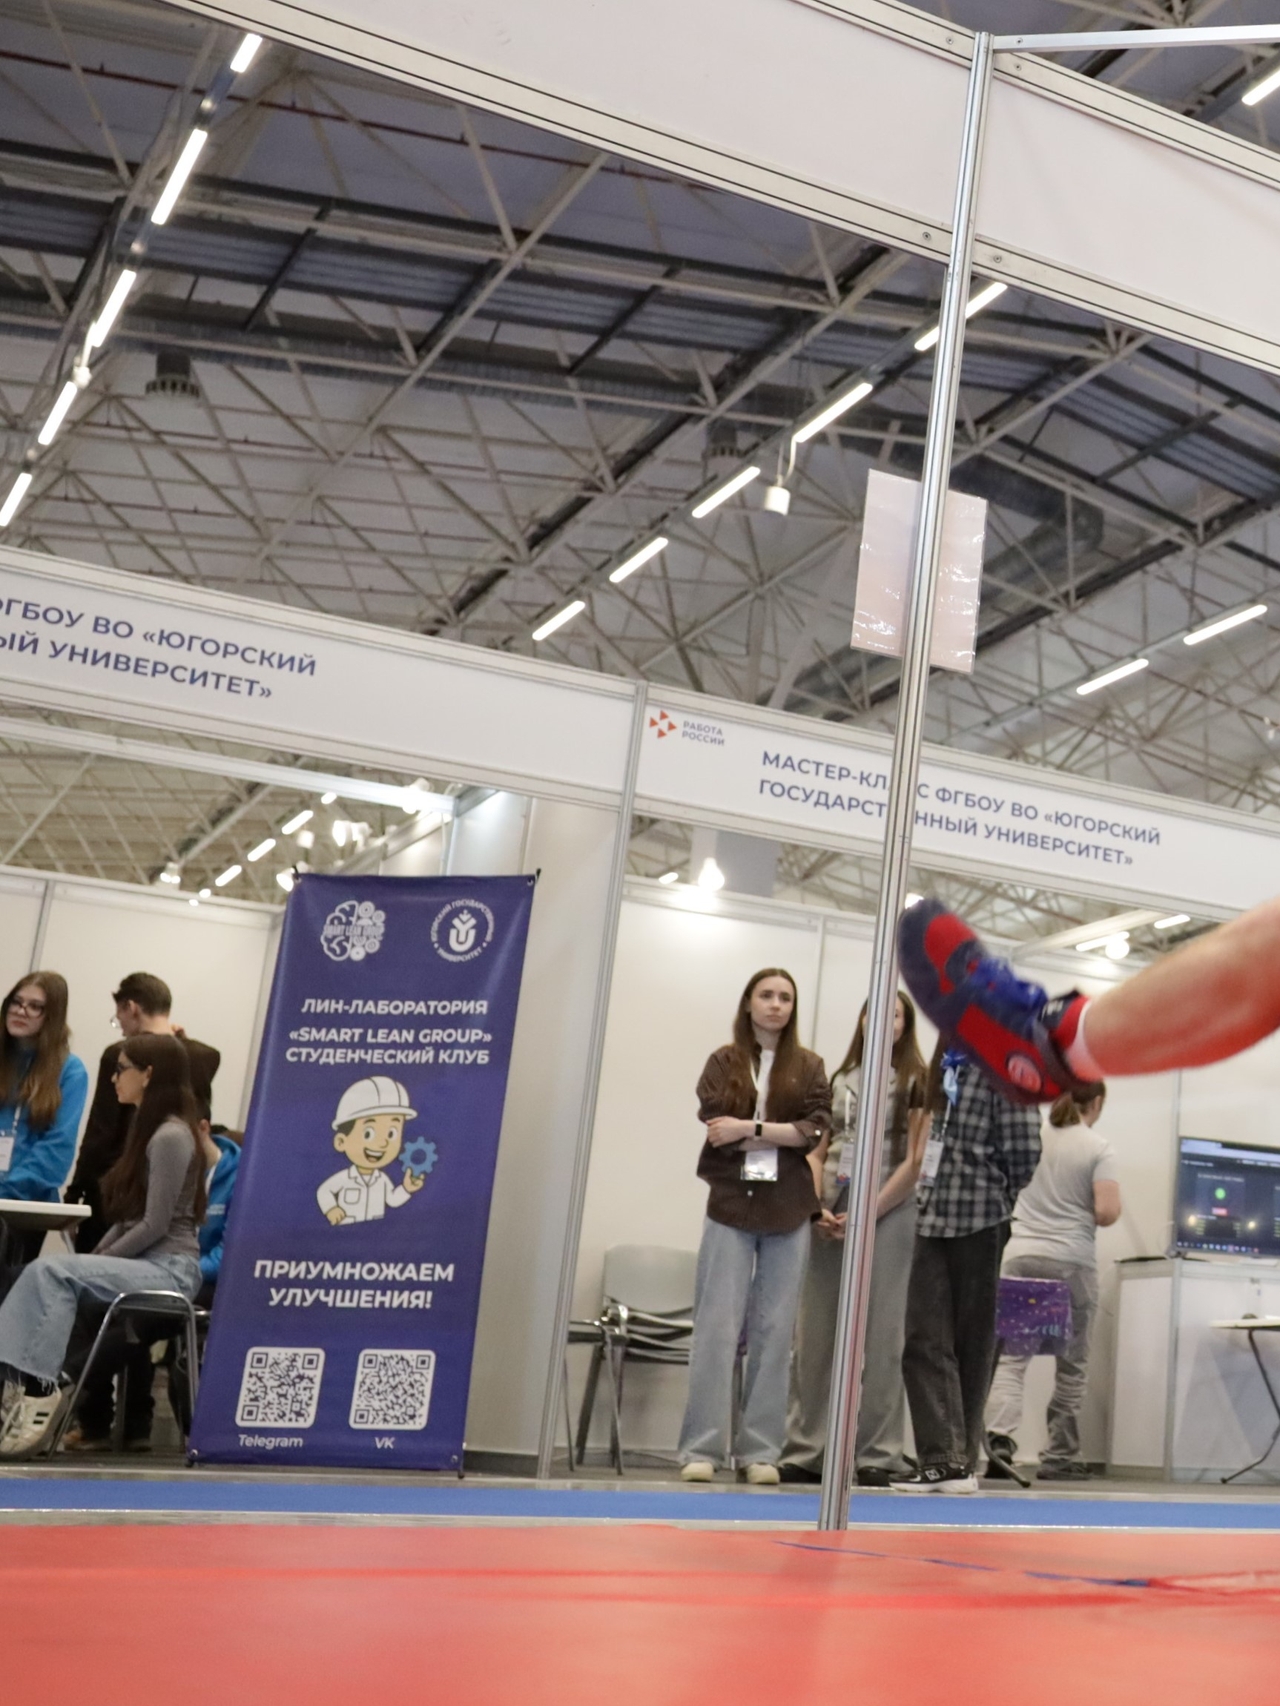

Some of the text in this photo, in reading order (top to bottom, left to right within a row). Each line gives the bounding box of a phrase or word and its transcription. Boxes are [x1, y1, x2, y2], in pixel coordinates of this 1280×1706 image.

[0, 598, 317, 677] ГБОУ ВО «ЮГОРСКИЙ
[48, 640, 273, 699] УНИВЕРСИТЕТ»
[683, 720, 723, 736] РАБОТА
[682, 731, 725, 746] РОССИИ
[762, 750, 1161, 846] МАСТЕР-КЛС ФГБОУ ВО «ЮГОРСКИЙ
[759, 779, 1134, 866] ГОСУДАРСТННЫЙ УНИВЕРСИТЕТ»
[301, 999, 488, 1015] ЛИН-ЛАБОРАТОРИЯ
[289, 1027, 492, 1044] «SMART LEAN GROUP»
[286, 1047, 490, 1065] СТУДЕНЧЕСКИЙ КЛУБ
[254, 1260, 455, 1282] ПРИУМНОЖАЕМ
[269, 1288, 433, 1309] УЛУЧШЕНИЯ!
[238, 1434, 304, 1450] Telegram
[375, 1437, 395, 1450] VK
